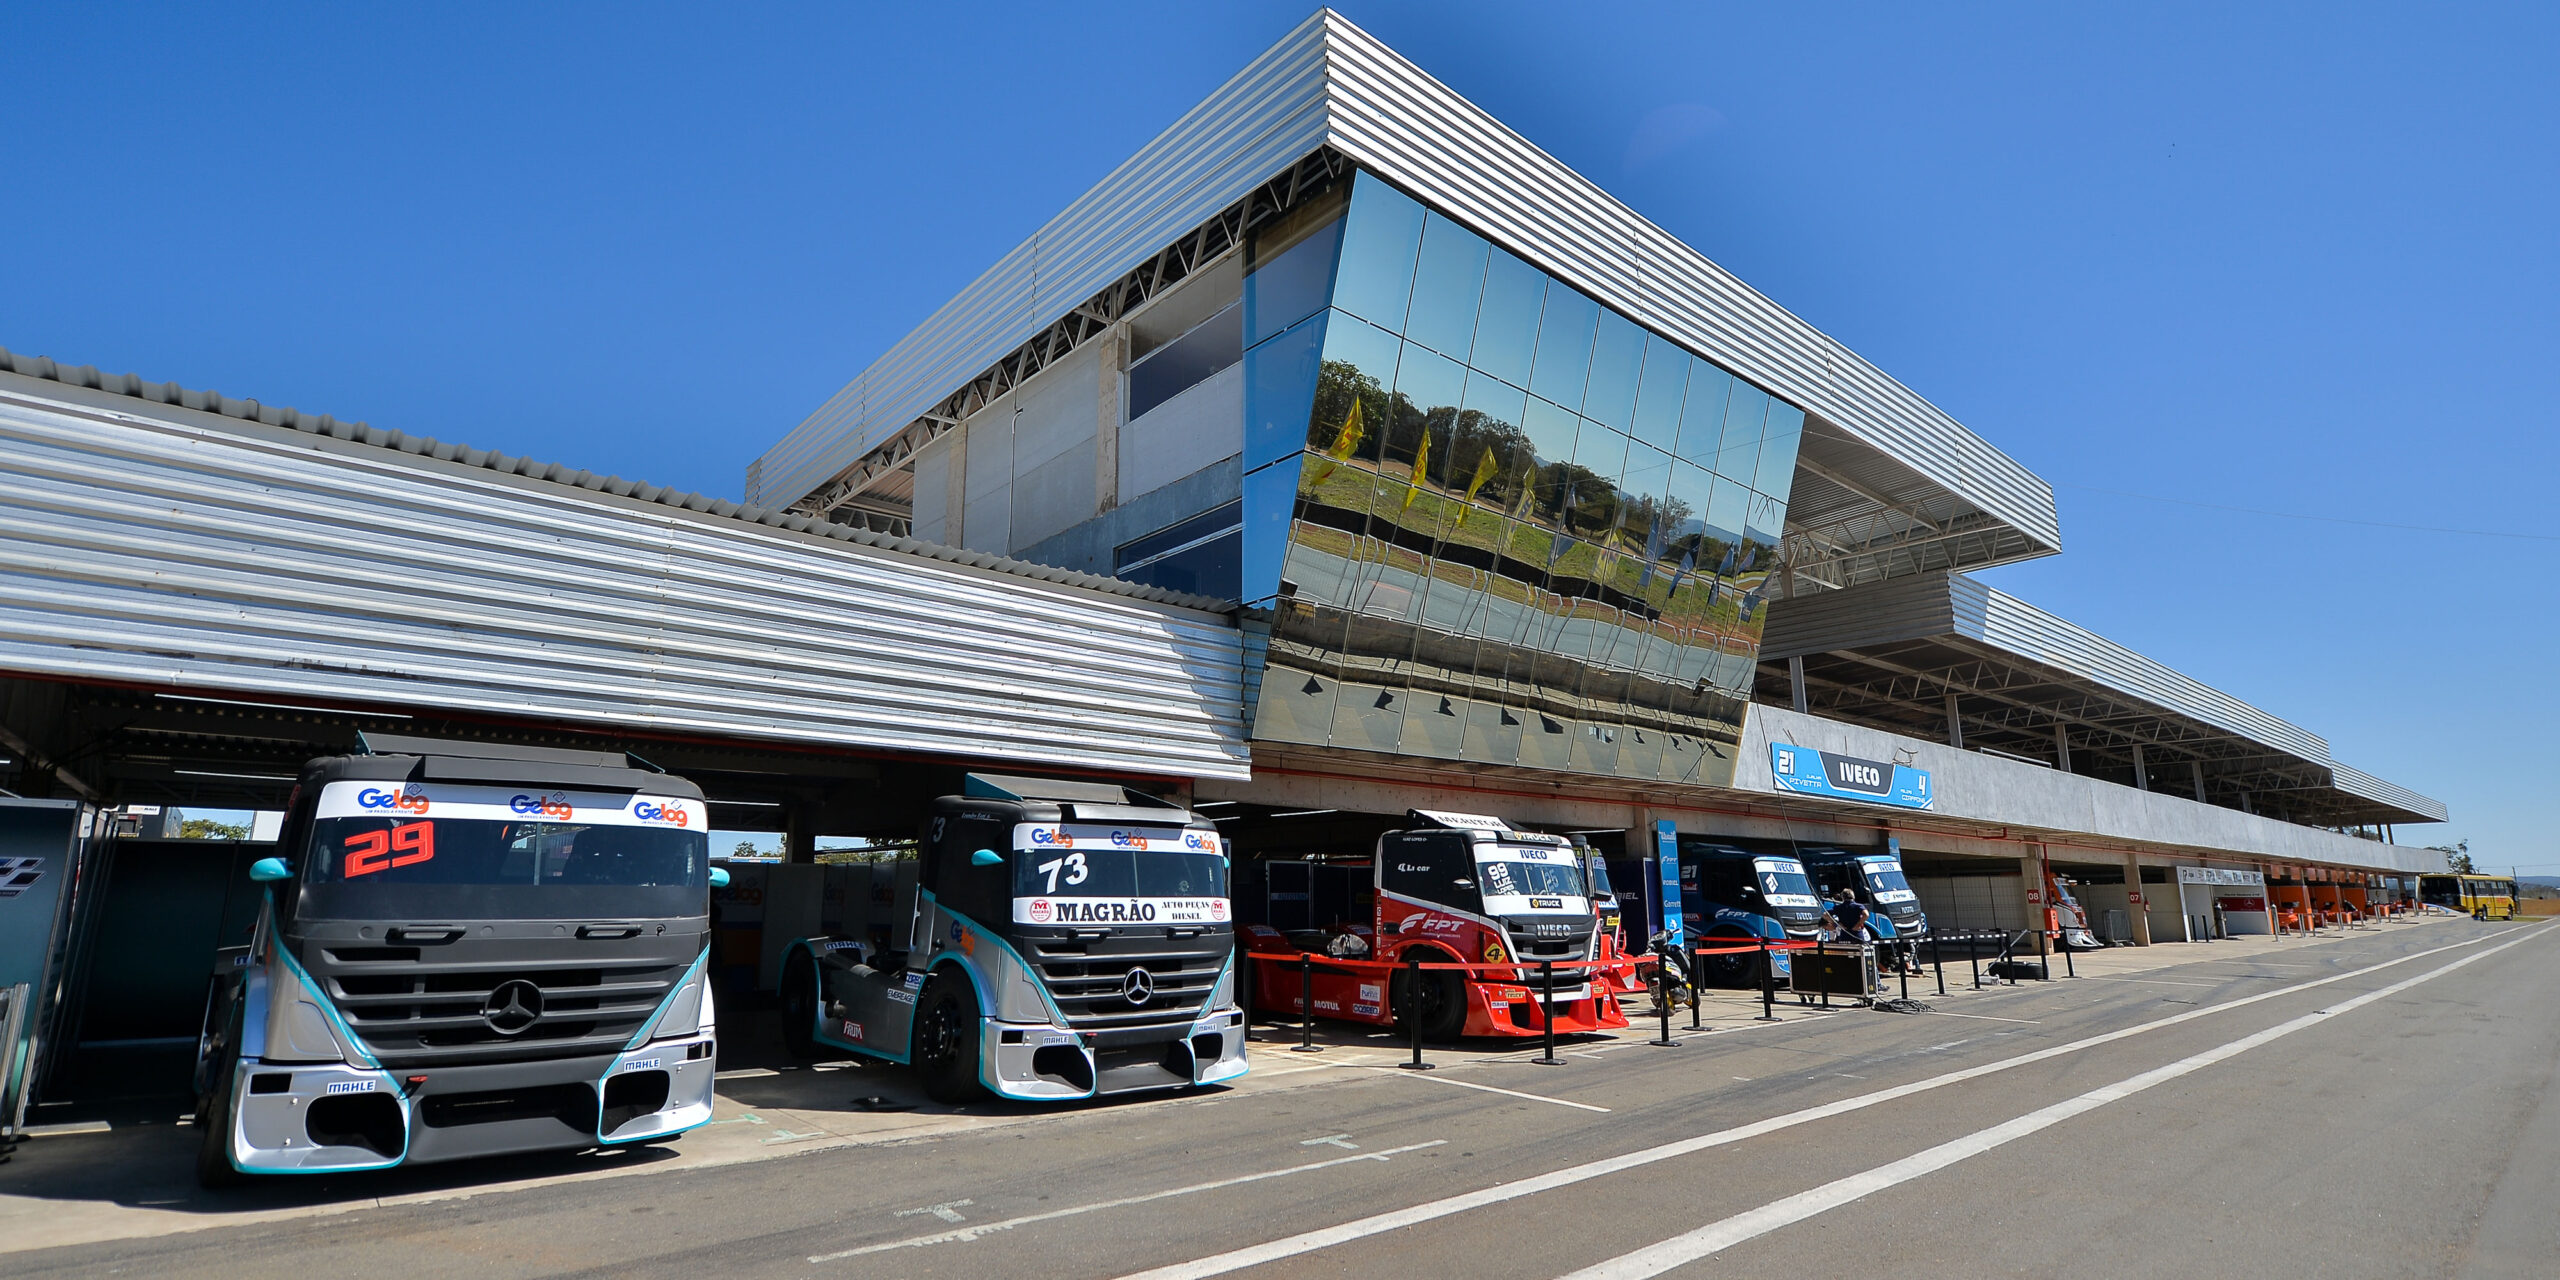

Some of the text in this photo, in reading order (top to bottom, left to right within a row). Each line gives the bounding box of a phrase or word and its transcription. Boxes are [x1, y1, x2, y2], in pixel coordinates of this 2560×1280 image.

[1779, 750, 1795, 775] 21
[1840, 762, 1880, 787] IVECO
[1789, 777, 1822, 788] PIVETTA
[1919, 775, 1926, 796] 4
[358, 788, 430, 815] Gelog
[510, 794, 573, 821] Gelog
[634, 801, 688, 827] Gelog
[1031, 828, 1073, 848] Gelog
[1111, 830, 1148, 850] Gelog
[1185, 834, 1216, 853] Gelog
[344, 820, 435, 879] 29
[1520, 850, 1548, 860] IVECO
[1038, 852, 1088, 894] 73
[1487, 862, 1509, 881] 99
[1681, 865, 1698, 879] 21
[1774, 862, 1795, 872] IVECO
[1493, 876, 1513, 889] LUIZ
[1539, 899, 1561, 907] TRUCK
[2028, 892, 2039, 901] 08
[1056, 899, 1156, 922] MAGRÃO
[1162, 901, 1210, 910] AUTO PEÇAS
[1172, 912, 1202, 920] DIESEL
[1796, 912, 1813, 920] IVECO
[1422, 919, 1465, 932] FPT
[1537, 924, 1572, 937] IVECO
[825, 942, 867, 950] MAHLE
[1314, 1000, 1340, 1011] MOTUL
[1043, 1036, 1068, 1044] MAHLE
[625, 1059, 660, 1071] MAHLE
[328, 1081, 374, 1093] MAHLE
